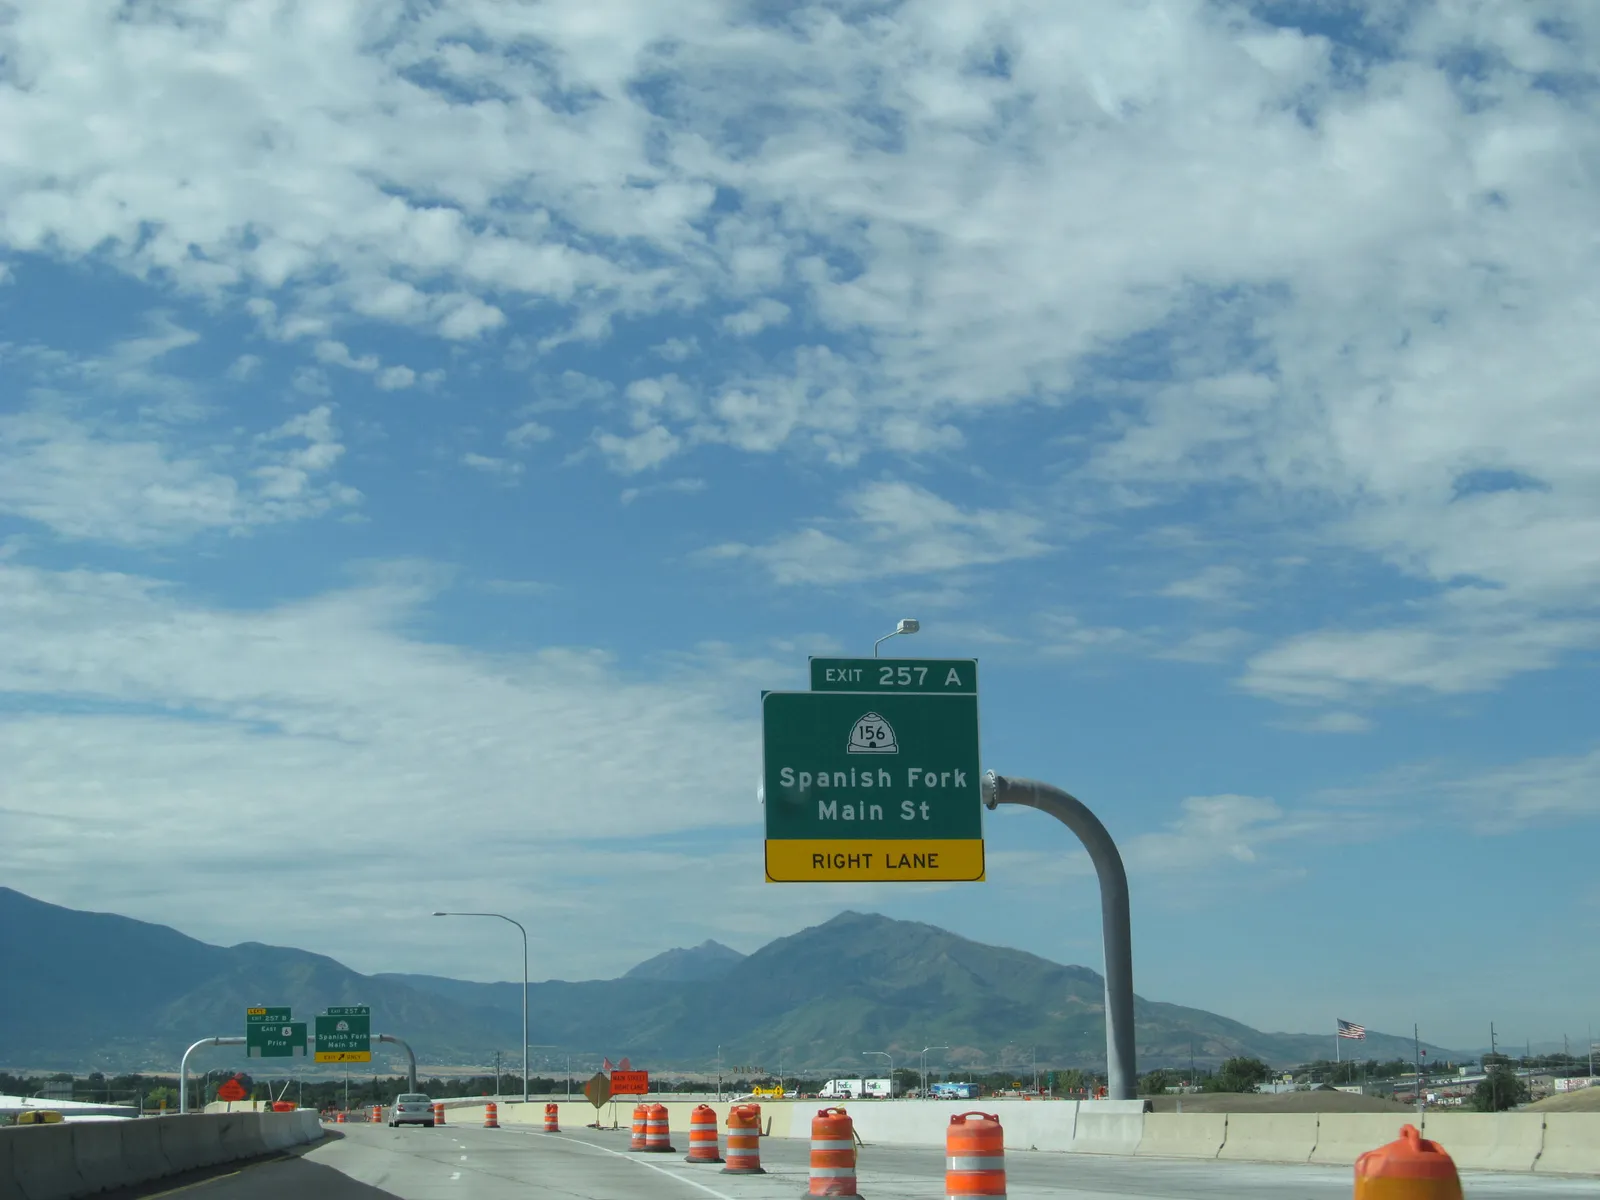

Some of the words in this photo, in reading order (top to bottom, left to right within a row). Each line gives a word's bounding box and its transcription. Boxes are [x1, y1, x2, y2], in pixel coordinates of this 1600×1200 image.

[825, 668, 863, 682] EXIT
[878, 666, 929, 686] 257
[944, 667, 962, 686] A
[858, 725, 886, 740] 156
[779, 767, 892, 792] Spanish
[907, 767, 968, 788] Fork
[818, 800, 883, 821] Main
[899, 800, 930, 821] St
[812, 853, 873, 869] RIGHT
[885, 853, 939, 869] LANE
